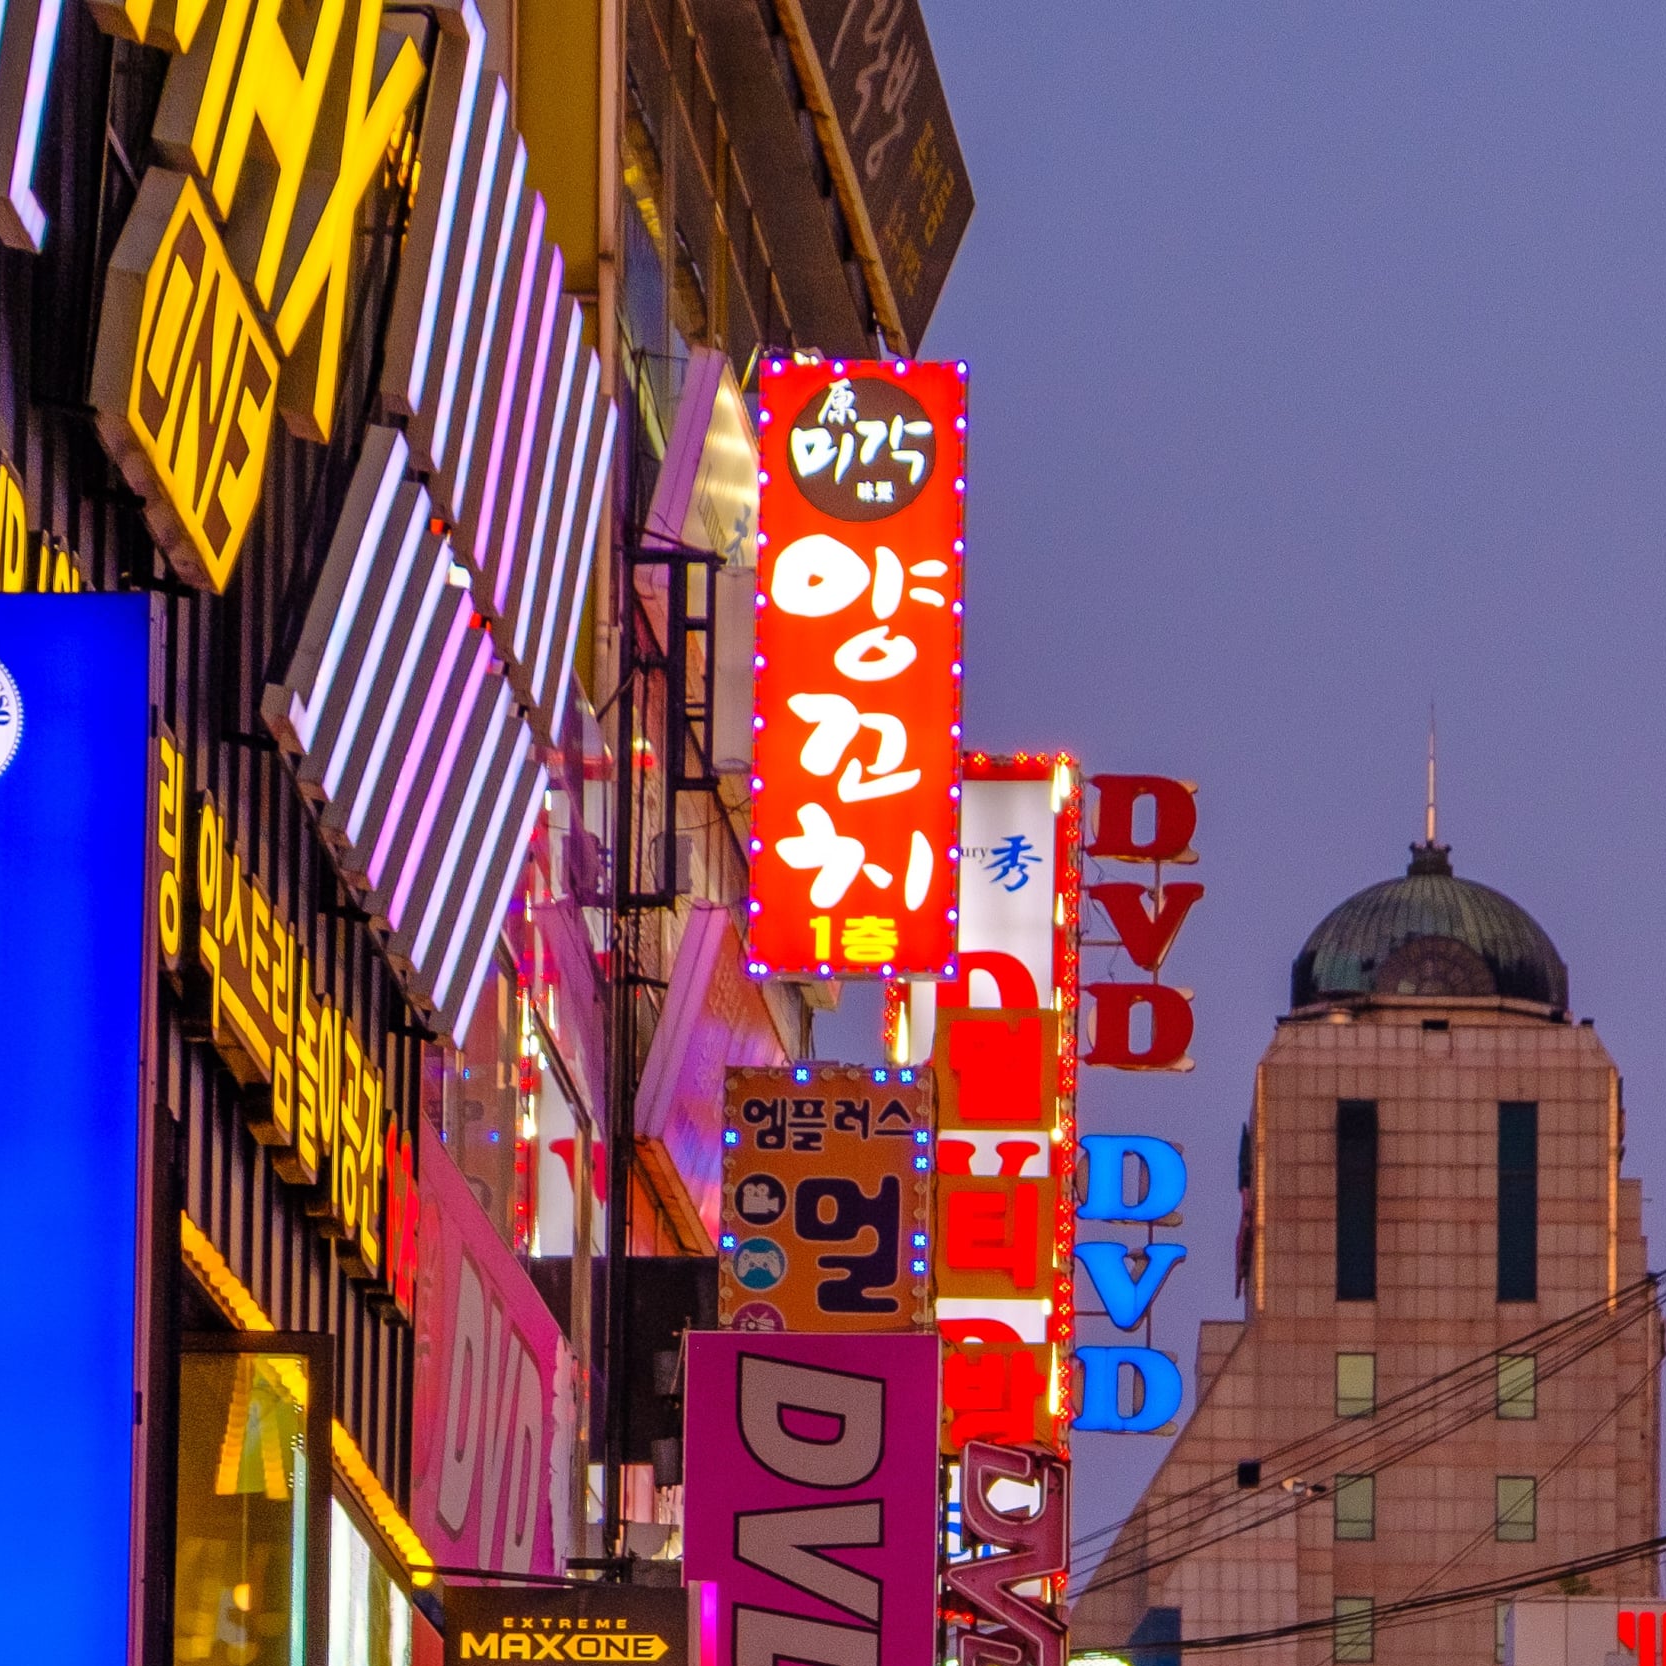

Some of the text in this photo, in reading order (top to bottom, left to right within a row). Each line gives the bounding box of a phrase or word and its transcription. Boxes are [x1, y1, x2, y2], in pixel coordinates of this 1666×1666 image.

[791, 415, 933, 484] 미각
[809, 916, 899, 963] 1층
[1084, 773, 1204, 1068] DVD
[742, 1098, 914, 1152] 엠플러스
[1074, 1133, 1188, 1434] DVD
[503, 1618, 628, 1630] EXTREME
